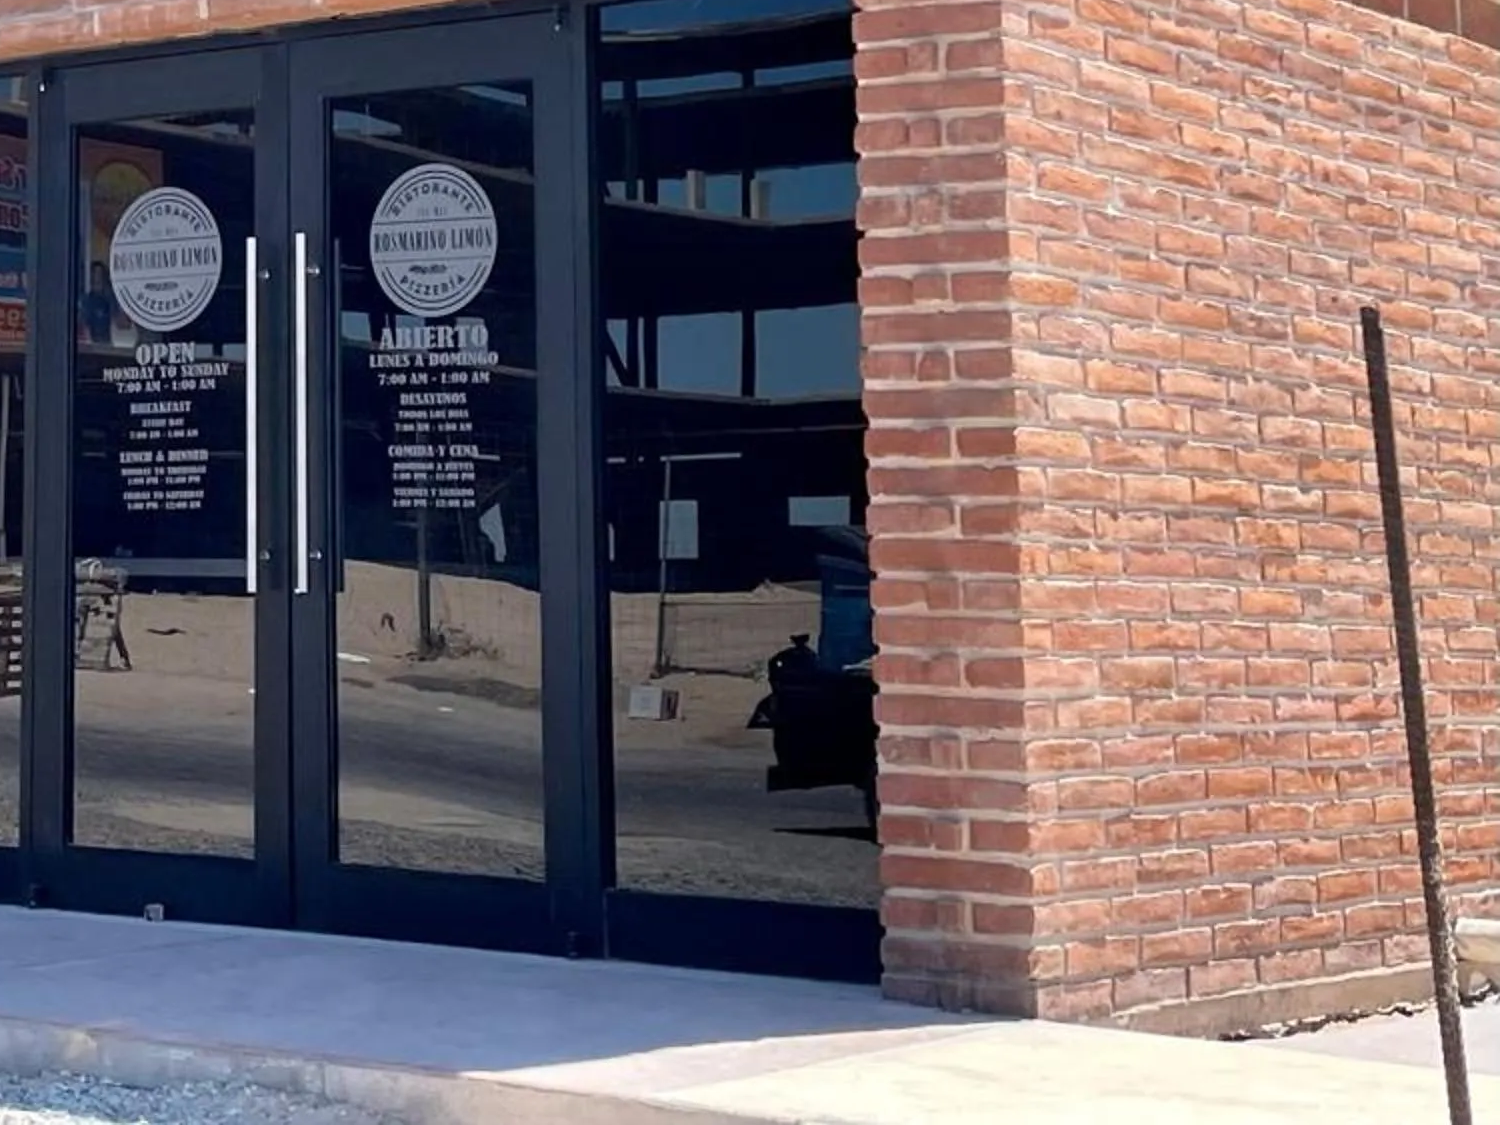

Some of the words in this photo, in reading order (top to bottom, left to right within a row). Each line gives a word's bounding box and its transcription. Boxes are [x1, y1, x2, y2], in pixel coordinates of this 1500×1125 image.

[391, 182, 476, 216] RISTORANTE
[374, 230, 447, 253] ROSMARINO
[380, 325, 489, 350] ABIERTO
[136, 341, 195, 365] OPEN
[369, 353, 411, 368] LUNES
[414, 353, 425, 367] A
[428, 351, 499, 366] DOMINGO
[103, 366, 155, 382] MONDAY
[160, 365, 177, 378] TO
[181, 363, 229, 377] SUNDAY
[378, 373, 407, 386] 7:00
[410, 373, 428, 384] AM
[471, 371, 490, 383] AM
[116, 381, 142, 394] 7:00
[145, 381, 161, 392] AM
[199, 378, 216, 390] AM
